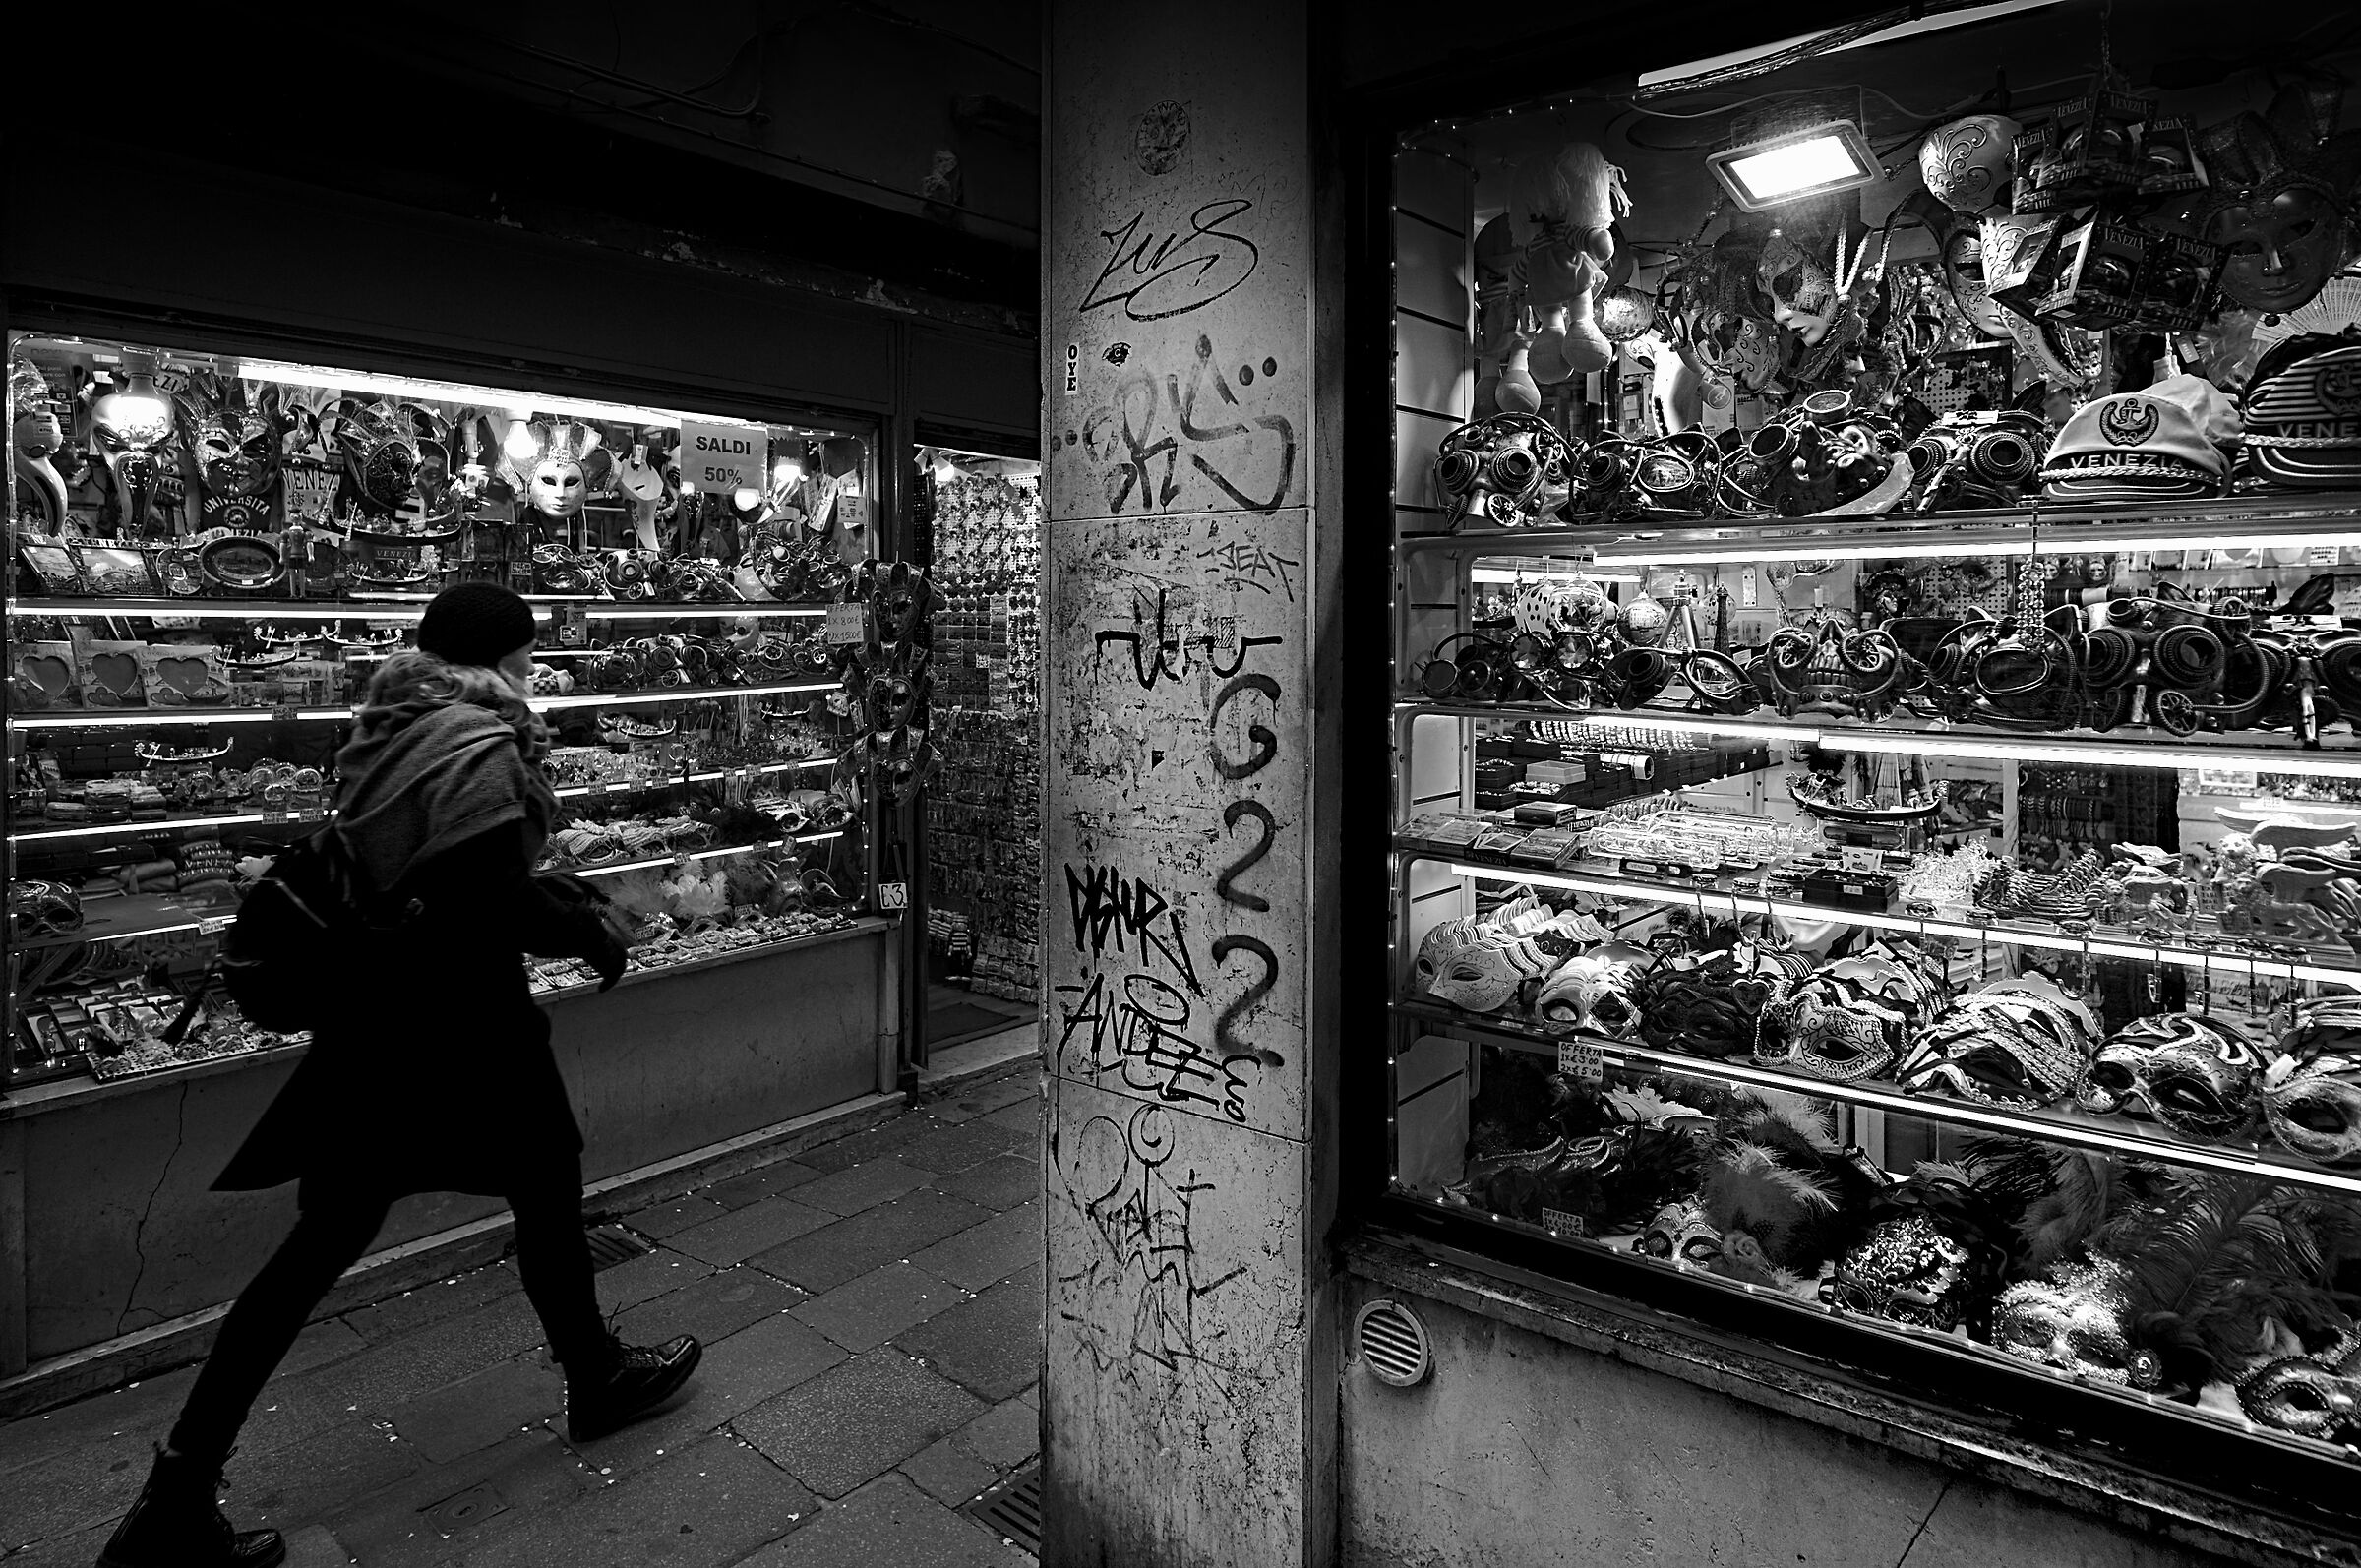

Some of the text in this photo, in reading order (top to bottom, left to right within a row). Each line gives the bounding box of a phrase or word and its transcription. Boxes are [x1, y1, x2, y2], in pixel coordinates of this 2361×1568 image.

[2110, 94, 2148, 114] VENEZIA
[2105, 228, 2143, 249] VENEZIA
[2177, 238, 2215, 260] VENEZIA
[1067, 344, 1078, 392] OYE
[696, 436, 751, 455] SALDI
[2070, 453, 2184, 469] VENEZIA
[704, 467, 743, 485] 50%
[1560, 1044, 1602, 1057] OFFERTA
